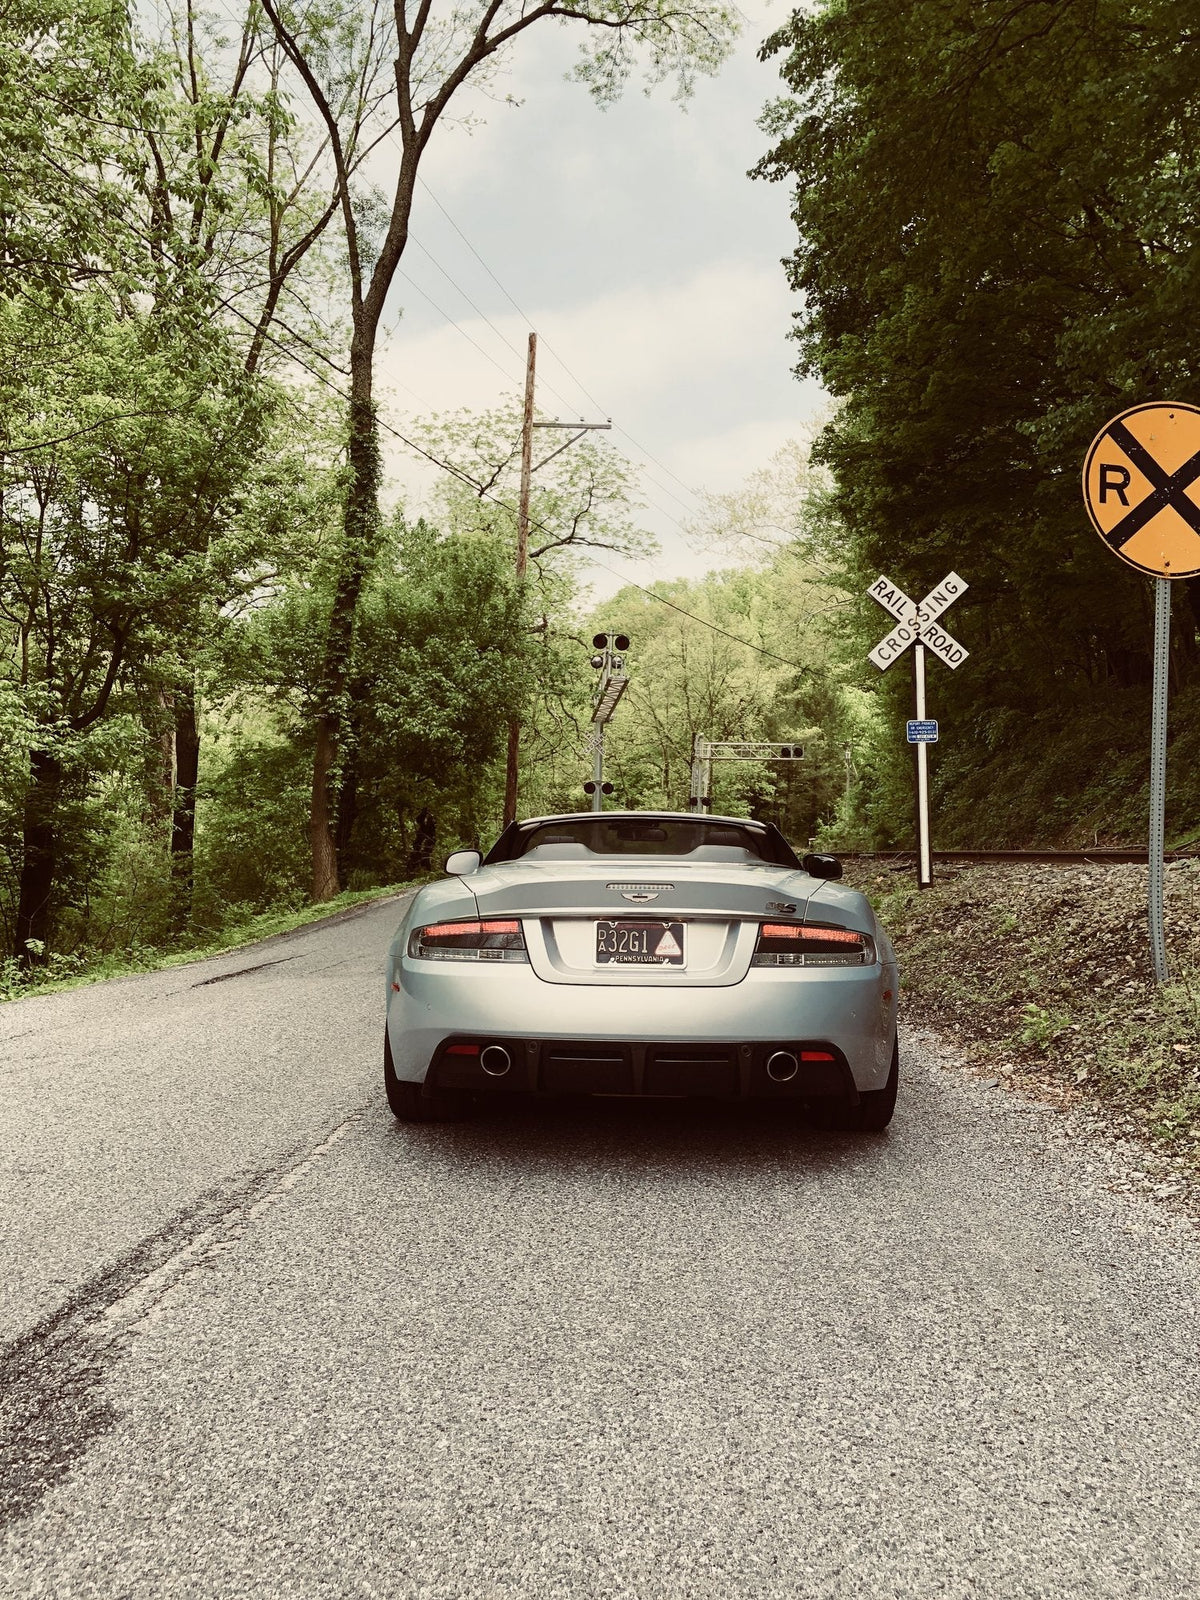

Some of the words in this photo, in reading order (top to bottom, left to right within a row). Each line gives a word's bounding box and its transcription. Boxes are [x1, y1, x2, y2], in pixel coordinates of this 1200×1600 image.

[872, 580, 907, 617] RAIL
[923, 626, 963, 663] ROAD
[877, 581, 958, 661] CROSSING
[608, 929, 648, 954] 32G1
[615, 955, 664, 963] PENNSYLVANIA
